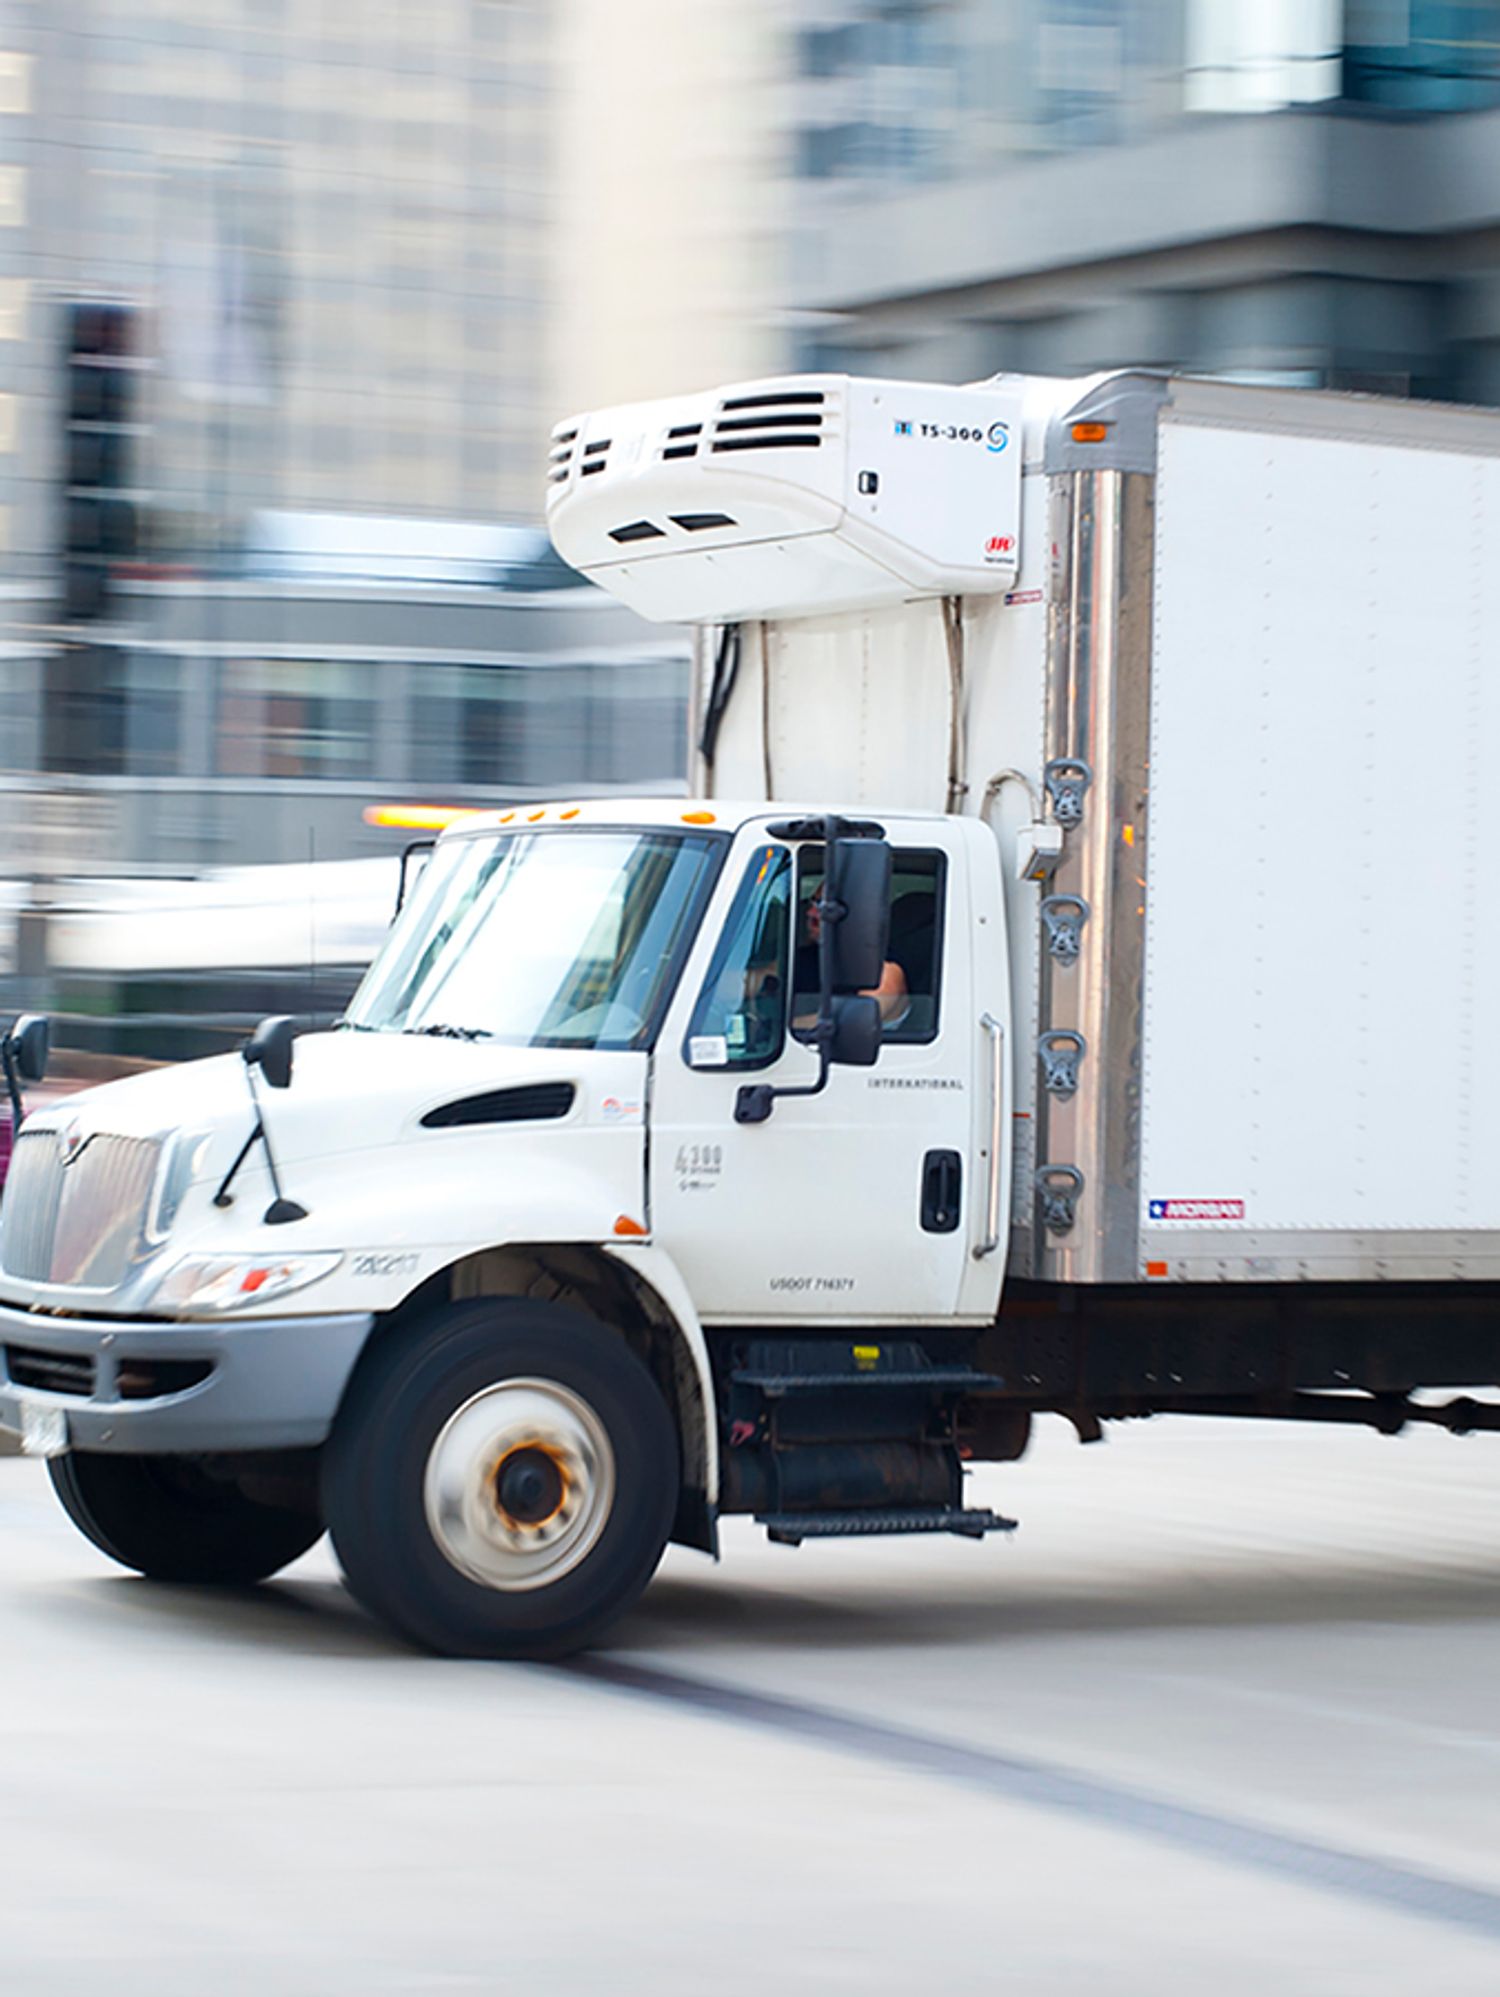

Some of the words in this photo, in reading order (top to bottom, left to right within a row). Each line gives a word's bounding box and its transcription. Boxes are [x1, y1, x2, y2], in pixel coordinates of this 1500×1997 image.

[920, 424, 983, 441] TS-300
[867, 1078, 963, 1090] INTERNATIONAL
[1165, 1202, 1241, 1217] MORGAN
[769, 1278, 812, 1291] USDOT
